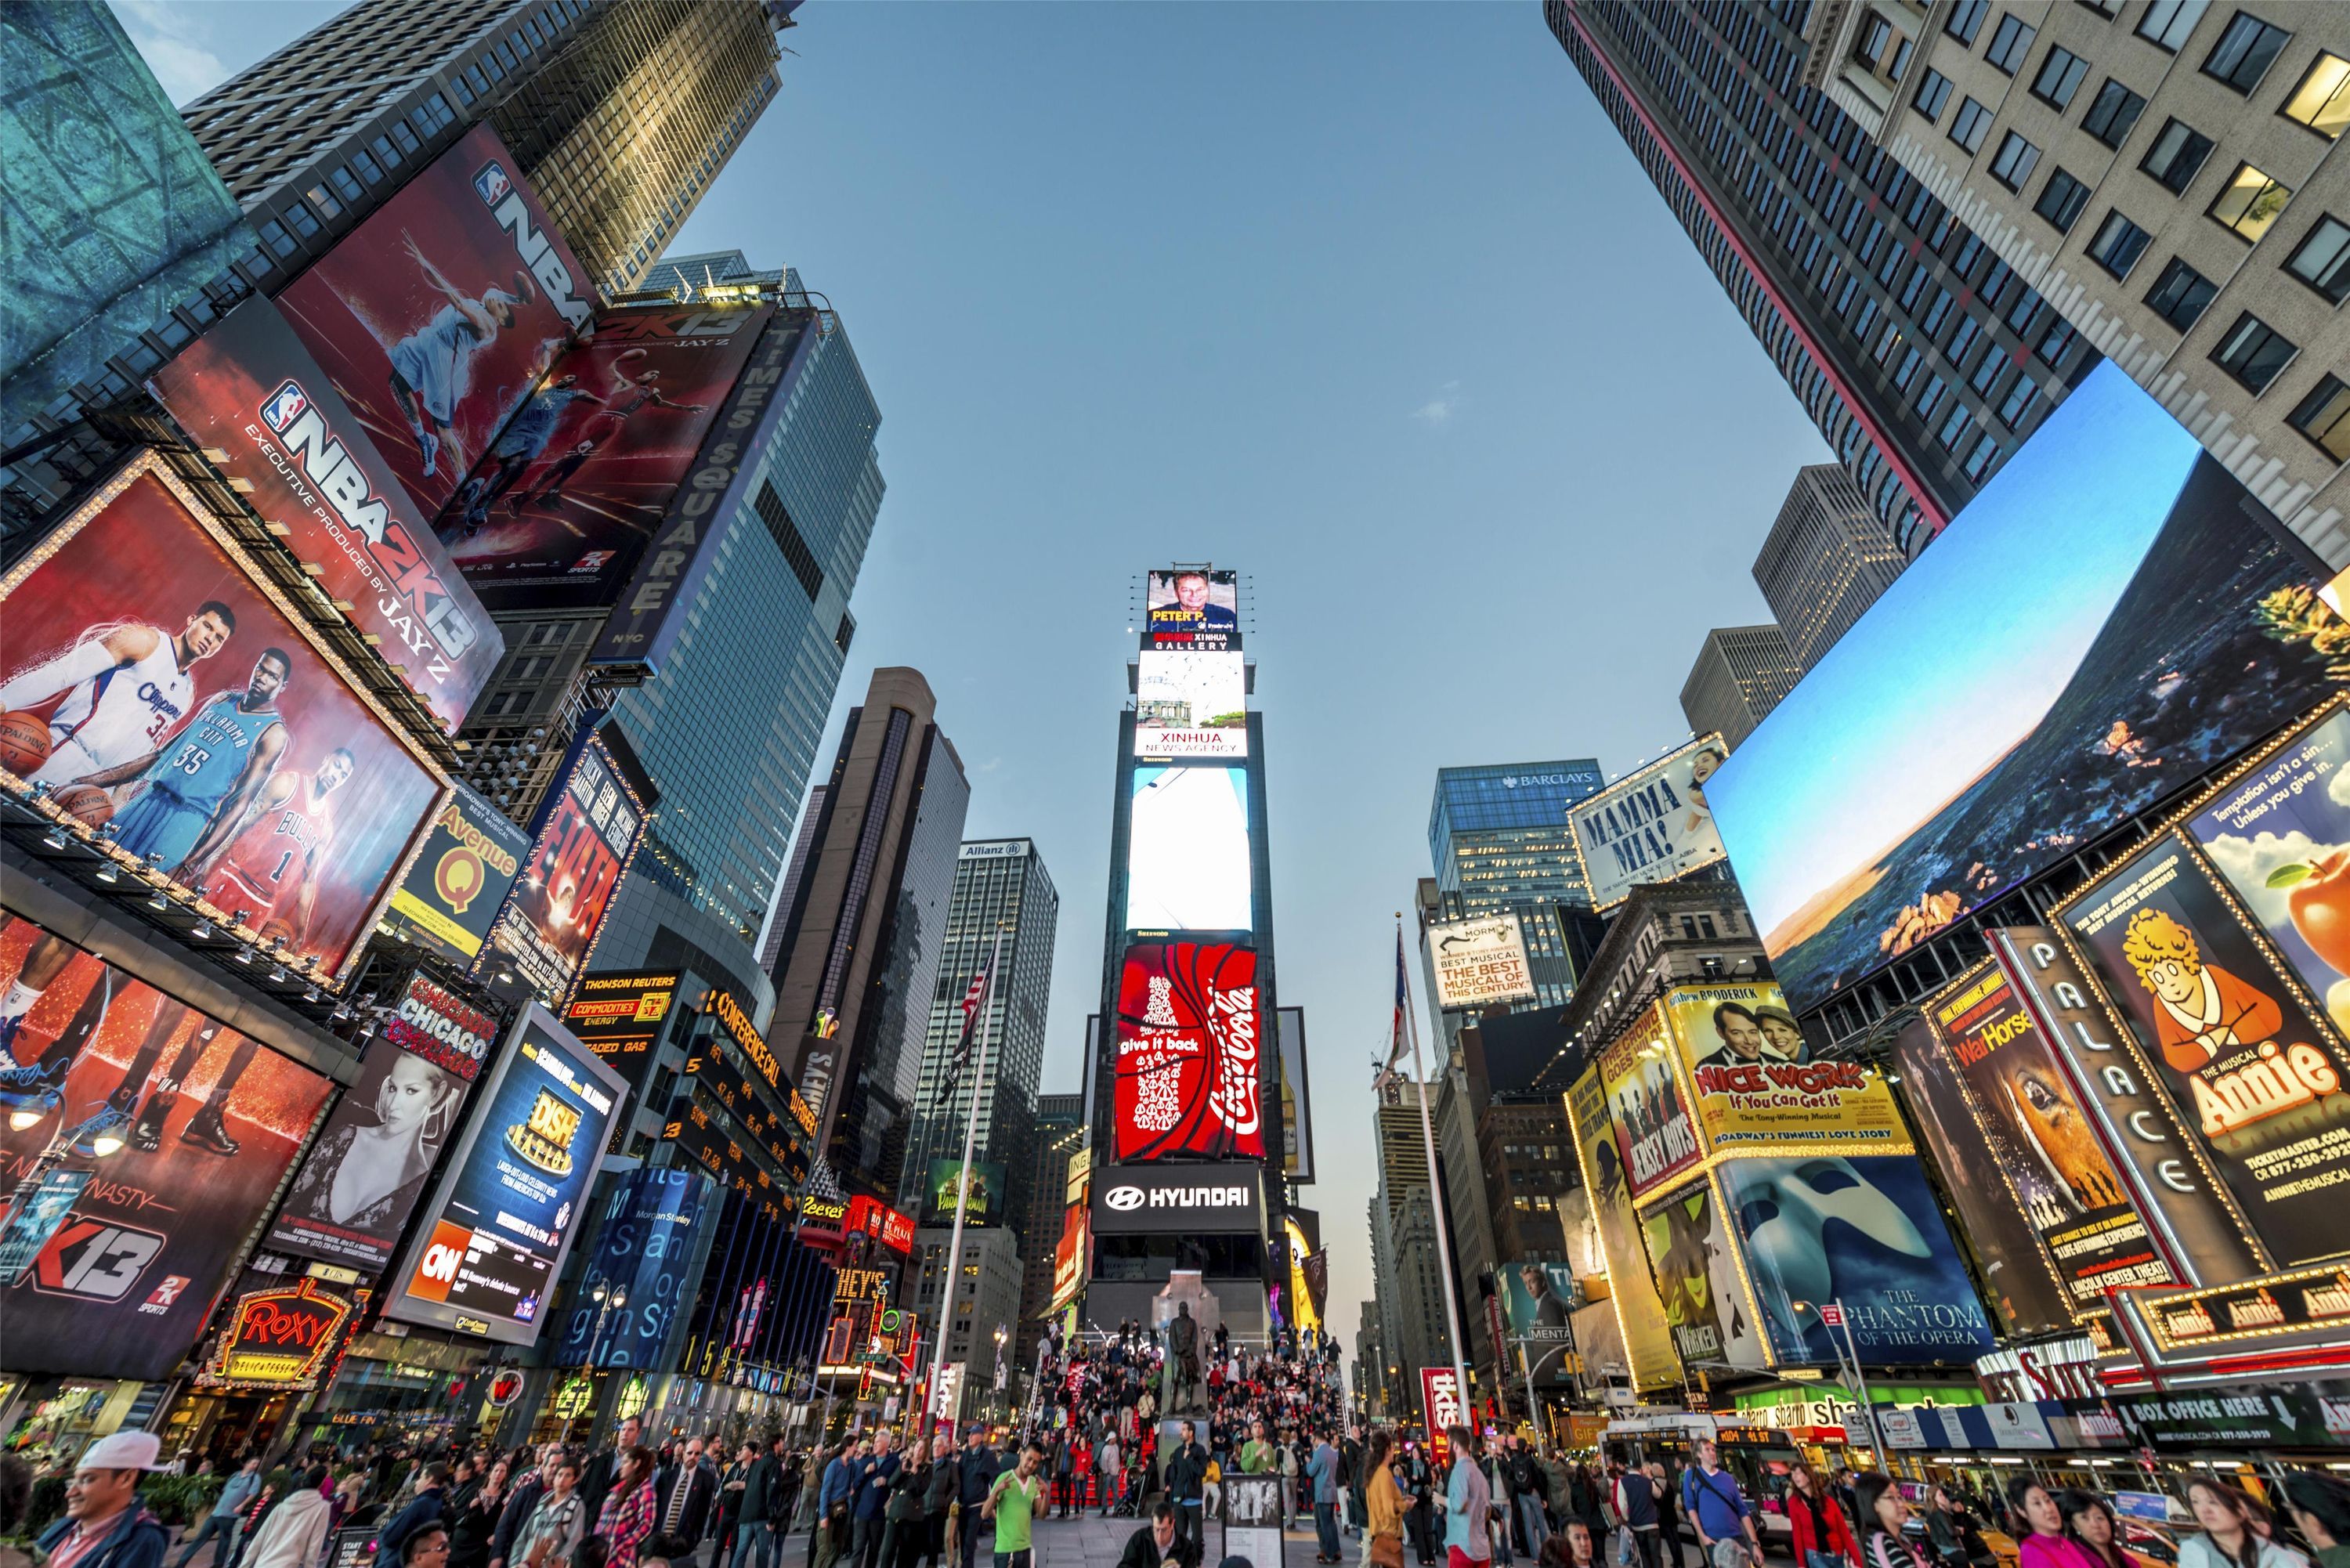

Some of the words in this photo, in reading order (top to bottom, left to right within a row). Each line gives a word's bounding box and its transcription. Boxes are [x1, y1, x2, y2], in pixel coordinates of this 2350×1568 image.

[674, 339, 712, 348] JAY
[727, 327, 801, 429] TIMES
[266, 410, 280, 427] NBA
[244, 425, 315, 507] EXECUTIVE
[630, 442, 738, 610] SQUARE
[313, 508, 373, 577] PRODUCED
[370, 574, 387, 594] BY
[378, 595, 432, 657] JAY
[1153, 612, 1191, 621] PETER
[1195, 612, 1206, 621] P.
[612, 634, 644, 643] NYC
[426, 654, 451, 685] Z
[198, 726, 226, 746] CITY
[202, 710, 248, 749] OKLAHOMA
[1161, 733, 1222, 742] XINHUA
[172, 743, 212, 775] 35
[582, 754, 602, 787] RICKY
[571, 775, 595, 809] MARTIN
[1521, 772, 1593, 786] BARCLAYS
[2211, 779, 2269, 824] Temptation
[2266, 764, 2292, 789] isn't
[2291, 759, 2301, 770] a
[457, 784, 490, 815] BROADWAY'S
[2232, 802, 2269, 829] Unless
[2269, 789, 2290, 811] you
[2289, 773, 2316, 797] give
[2315, 761, 2334, 780] in.
[468, 805, 483, 821] BEST
[484, 817, 508, 840] MUSICAL
[1582, 778, 1682, 851] MAMMA
[439, 804, 517, 877] Avenue
[966, 845, 1003, 856] Allianz
[1611, 820, 1673, 877] MIA!
[270, 851, 293, 883] 1
[529, 793, 620, 938] EVITA
[435, 846, 485, 915] Q
[2085, 917, 2105, 936] BEST
[2105, 896, 2139, 925] MUSICAL
[2137, 869, 2178, 905] RETURNS!
[2075, 916, 2092, 932] THE
[2088, 901, 2111, 922] TONY
[1441, 959, 1466, 968] BEST
[1470, 952, 1519, 964] MUSICAL
[1479, 960, 1520, 975] BEST
[585, 979, 632, 990] THOMSON
[632, 977, 676, 987] REUTERS
[1444, 975, 1502, 990] MUSICAL
[1505, 971, 1523, 981] OF
[1446, 988, 1470, 998] THIS
[1700, 988, 1757, 1001] BRODERICK
[576, 1003, 634, 1014] COMMODITIES
[584, 1017, 618, 1025] ENERGY
[400, 998, 486, 1060] CHICAGO
[718, 992, 768, 1071] CONFERENCE
[762, 1053, 780, 1088] CALL
[1603, 1047, 1621, 1068] THE
[1622, 1009, 1659, 1052] CROWD
[624, 1042, 647, 1052] GAS
[1120, 1039, 1148, 1054] give
[1152, 1037, 1163, 1050] it
[1166, 1036, 1198, 1052] back
[1607, 1058, 1633, 1083] GOES
[2032, 942, 2196, 1194] PALACE
[2200, 1068, 2218, 1079] THE
[2219, 1050, 2258, 1073] MUSICAL
[1694, 1064, 1769, 1097] NICE
[1765, 1061, 1867, 1093] WORK
[2189, 1040, 2341, 1137] Annie
[1729, 1096, 1741, 1109] If
[1744, 1097, 1770, 1109] You
[1771, 1094, 1798, 1107] Can
[1800, 1096, 1825, 1109] Get
[1827, 1094, 1841, 1107] It
[529, 1093, 580, 1148] DISH
[1758, 1114, 1809, 1122] Tony-Winning
[512, 1124, 571, 1172] NATION
[1631, 1127, 1667, 1185] JERSEY
[1663, 1113, 1696, 1163] BOYS
[1715, 1132, 1775, 1145] BROADWAY'S
[1777, 1131, 1826, 1140] FUNNIEST
[1828, 1131, 1856, 1140] LOVE
[1859, 1130, 1892, 1139] STORY
[2244, 1127, 2350, 1170] TICKETMASTER.COM
[501, 1174, 515, 1187] FROM
[528, 1176, 548, 1193] CELEBRITY
[545, 1186, 558, 1198] NEWS
[2254, 1167, 2270, 1181] OR
[84, 1177, 155, 1210] NASTY
[1149, 1187, 1249, 1207] HYUNDAI
[636, 1210, 666, 1220] Morgan
[666, 1212, 691, 1227] Stanley
[803, 1196, 844, 1219] Reese's
[273, 1230, 309, 1244] TELECHARGE.COM
[2062, 1231, 2081, 1243] CHANCE
[2087, 1225, 2098, 1234] SEE
[421, 1244, 463, 1283] CNN
[157, 1277, 179, 1305] 2K
[466, 1270, 490, 1287] Romney's
[489, 1278, 505, 1292] debate
[504, 1284, 520, 1295] bounce
[2070, 1276, 2104, 1295] LINCOLN
[2102, 1268, 2135, 1286] CENTER
[138, 1303, 168, 1315] SPORTS
[1884, 1290, 1919, 1304] THE
[1843, 1304, 1984, 1329] PHANTOM
[2166, 1307, 2215, 1339] Annie
[2228, 1297, 2285, 1329] Annie
[1858, 1331, 1879, 1346] OF
[1882, 1331, 1918, 1345] THE
[1921, 1331, 1979, 1346] OPERA
[234, 1360, 297, 1374] DELICATESSEN
[1433, 1373, 1458, 1429] tkts
[1741, 1404, 1767, 1428] sbarro
[1775, 1399, 1806, 1427] sbarro
[2133, 1402, 2169, 1422] BOX
[2167, 1400, 2218, 1421] OFFICE
[2220, 1396, 2269, 1418] HERE
[332, 1414, 357, 1424] BLUE
[360, 1414, 376, 1425] FIN
[2077, 1409, 2124, 1437] Annie
[1748, 1432, 1757, 1442] 41
[1759, 1432, 1770, 1442] ST
[342, 1541, 363, 1550] START
